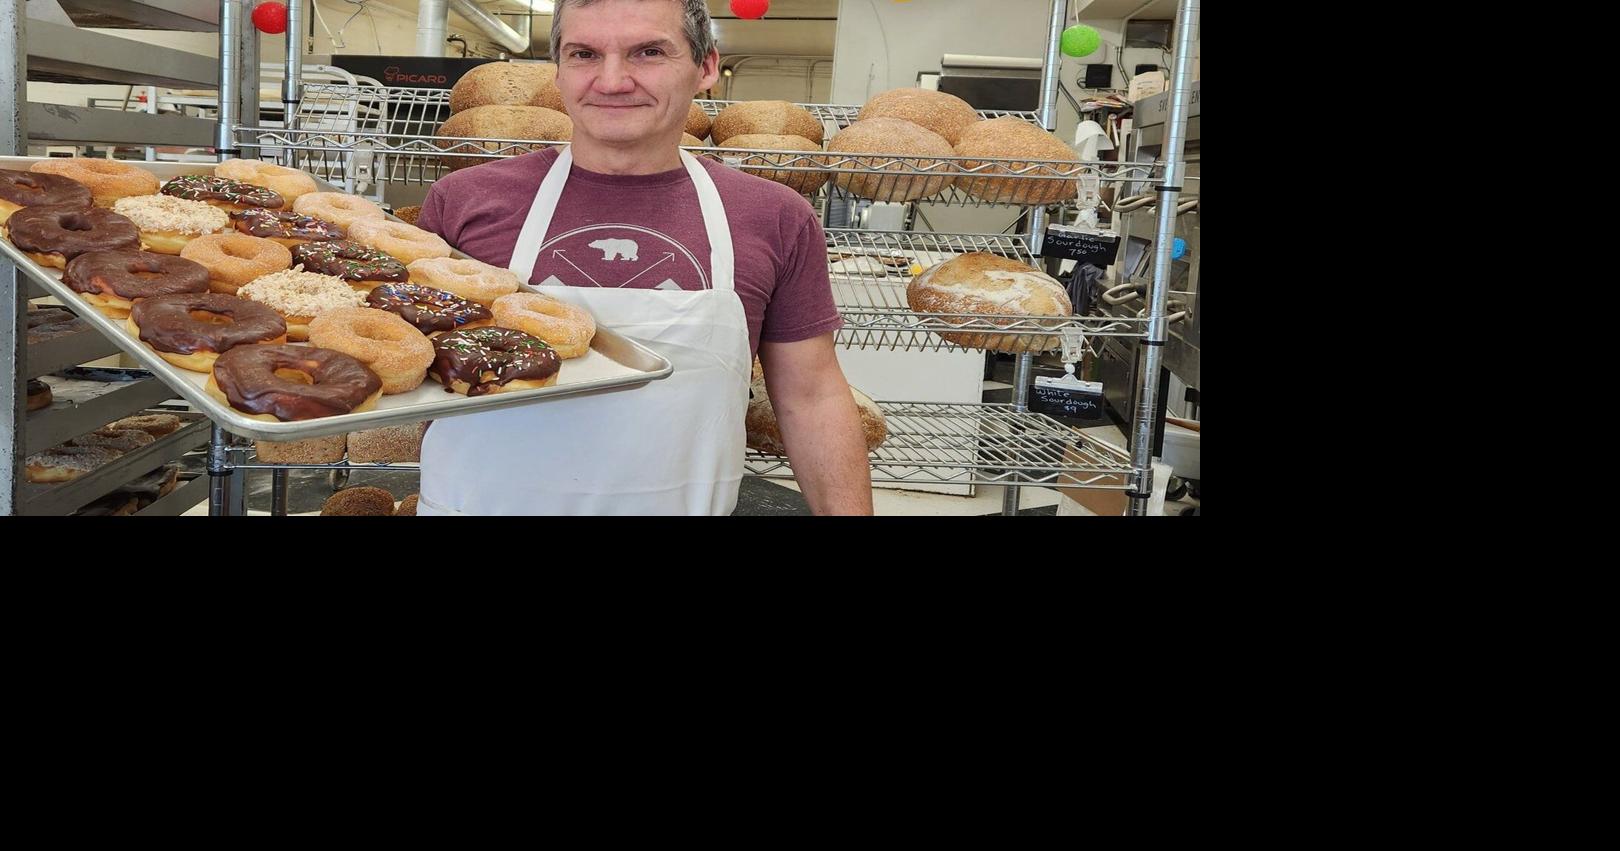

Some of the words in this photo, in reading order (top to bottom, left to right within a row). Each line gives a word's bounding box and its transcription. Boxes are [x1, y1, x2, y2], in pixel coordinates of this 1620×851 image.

[396, 74, 447, 84] PICARD
[1047, 236, 1107, 253] Sourdough
[1035, 388, 1070, 398] White
[1041, 395, 1097, 410] Sourdough
